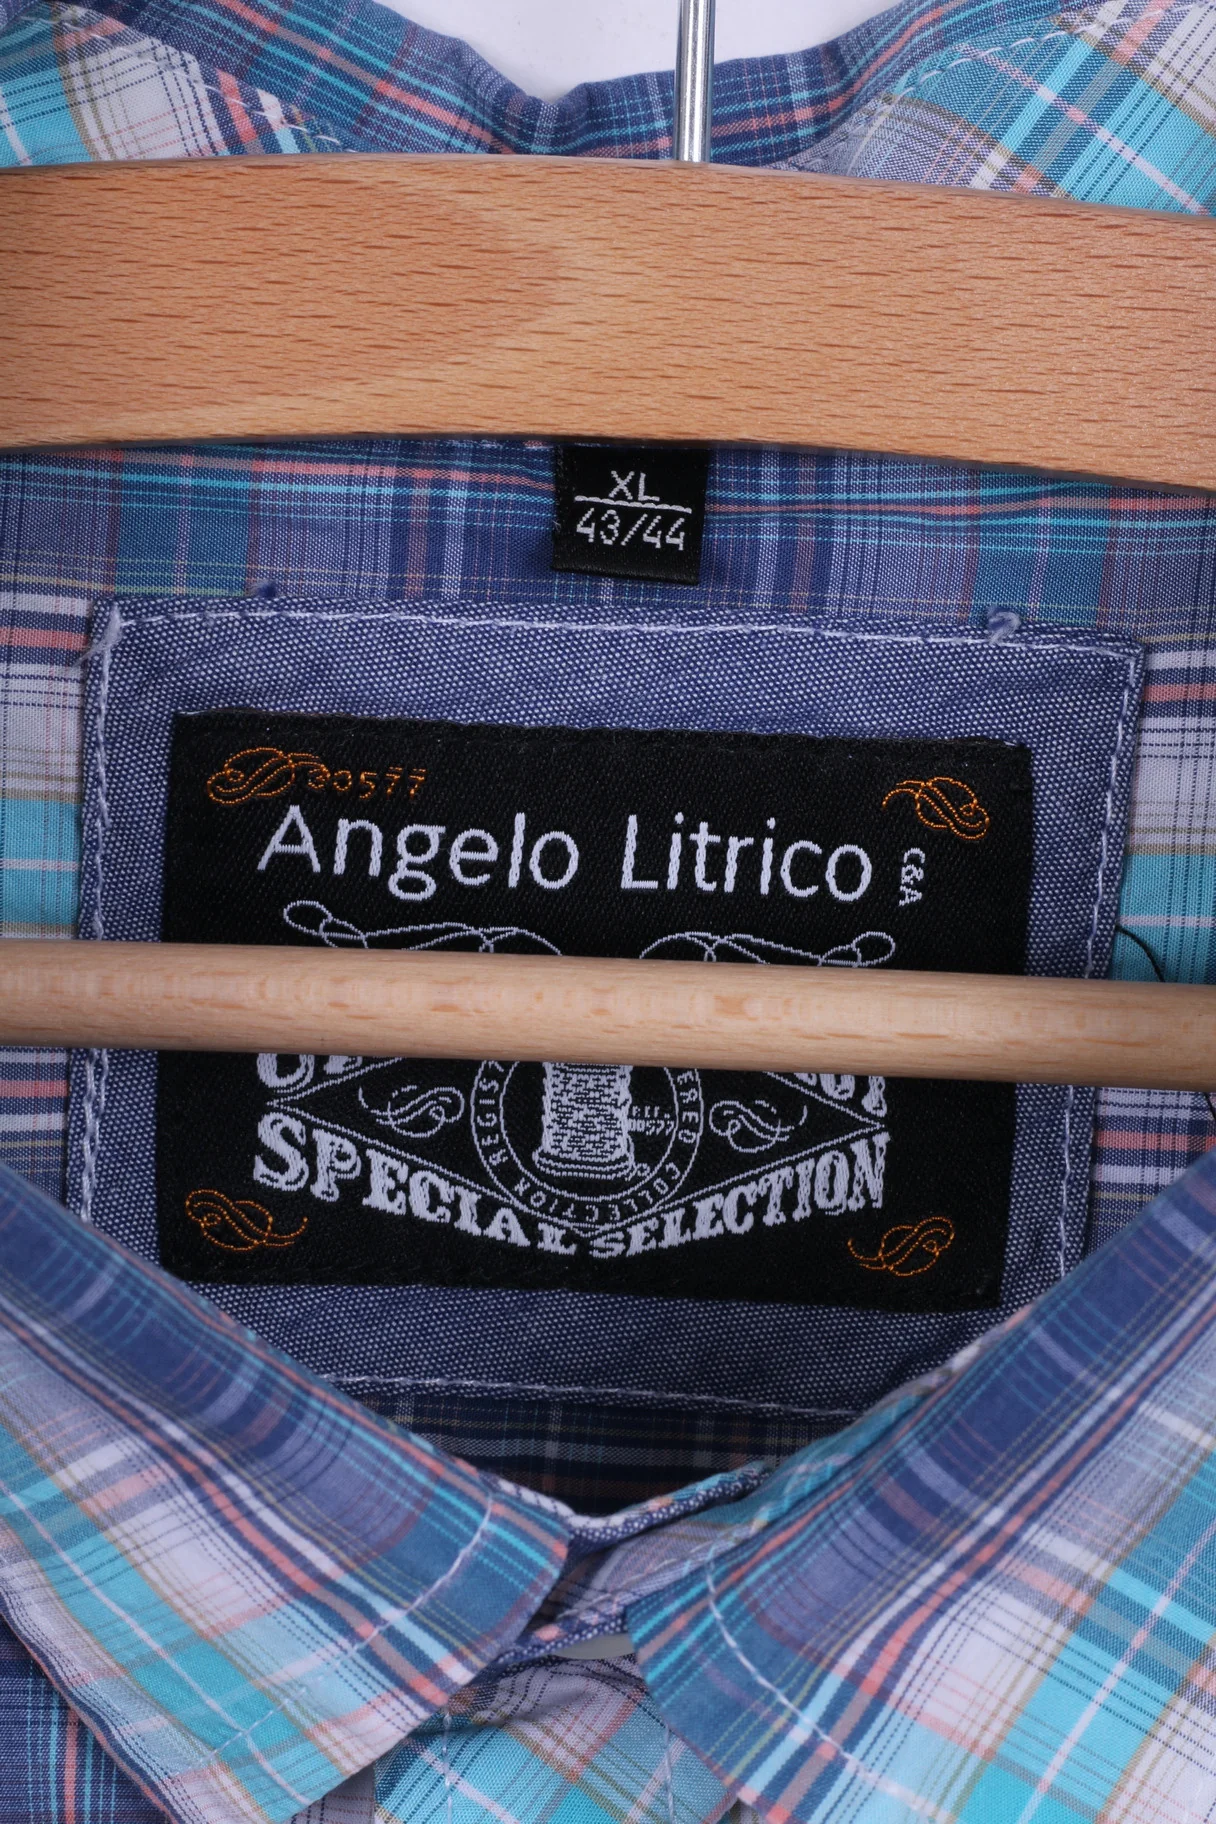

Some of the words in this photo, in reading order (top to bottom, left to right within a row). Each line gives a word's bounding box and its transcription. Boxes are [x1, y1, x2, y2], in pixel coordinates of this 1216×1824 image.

[609, 470, 660, 502] XL
[576, 508, 685, 551] 43/44
[257, 805, 580, 901] Angelo
[620, 811, 873, 902] Litrico
[899, 847, 926, 907] C&A
[252, 1111, 577, 1255] SPECIAL
[589, 1131, 891, 1259] SELECTION
[513, 1161, 682, 1222] COLLECTION
